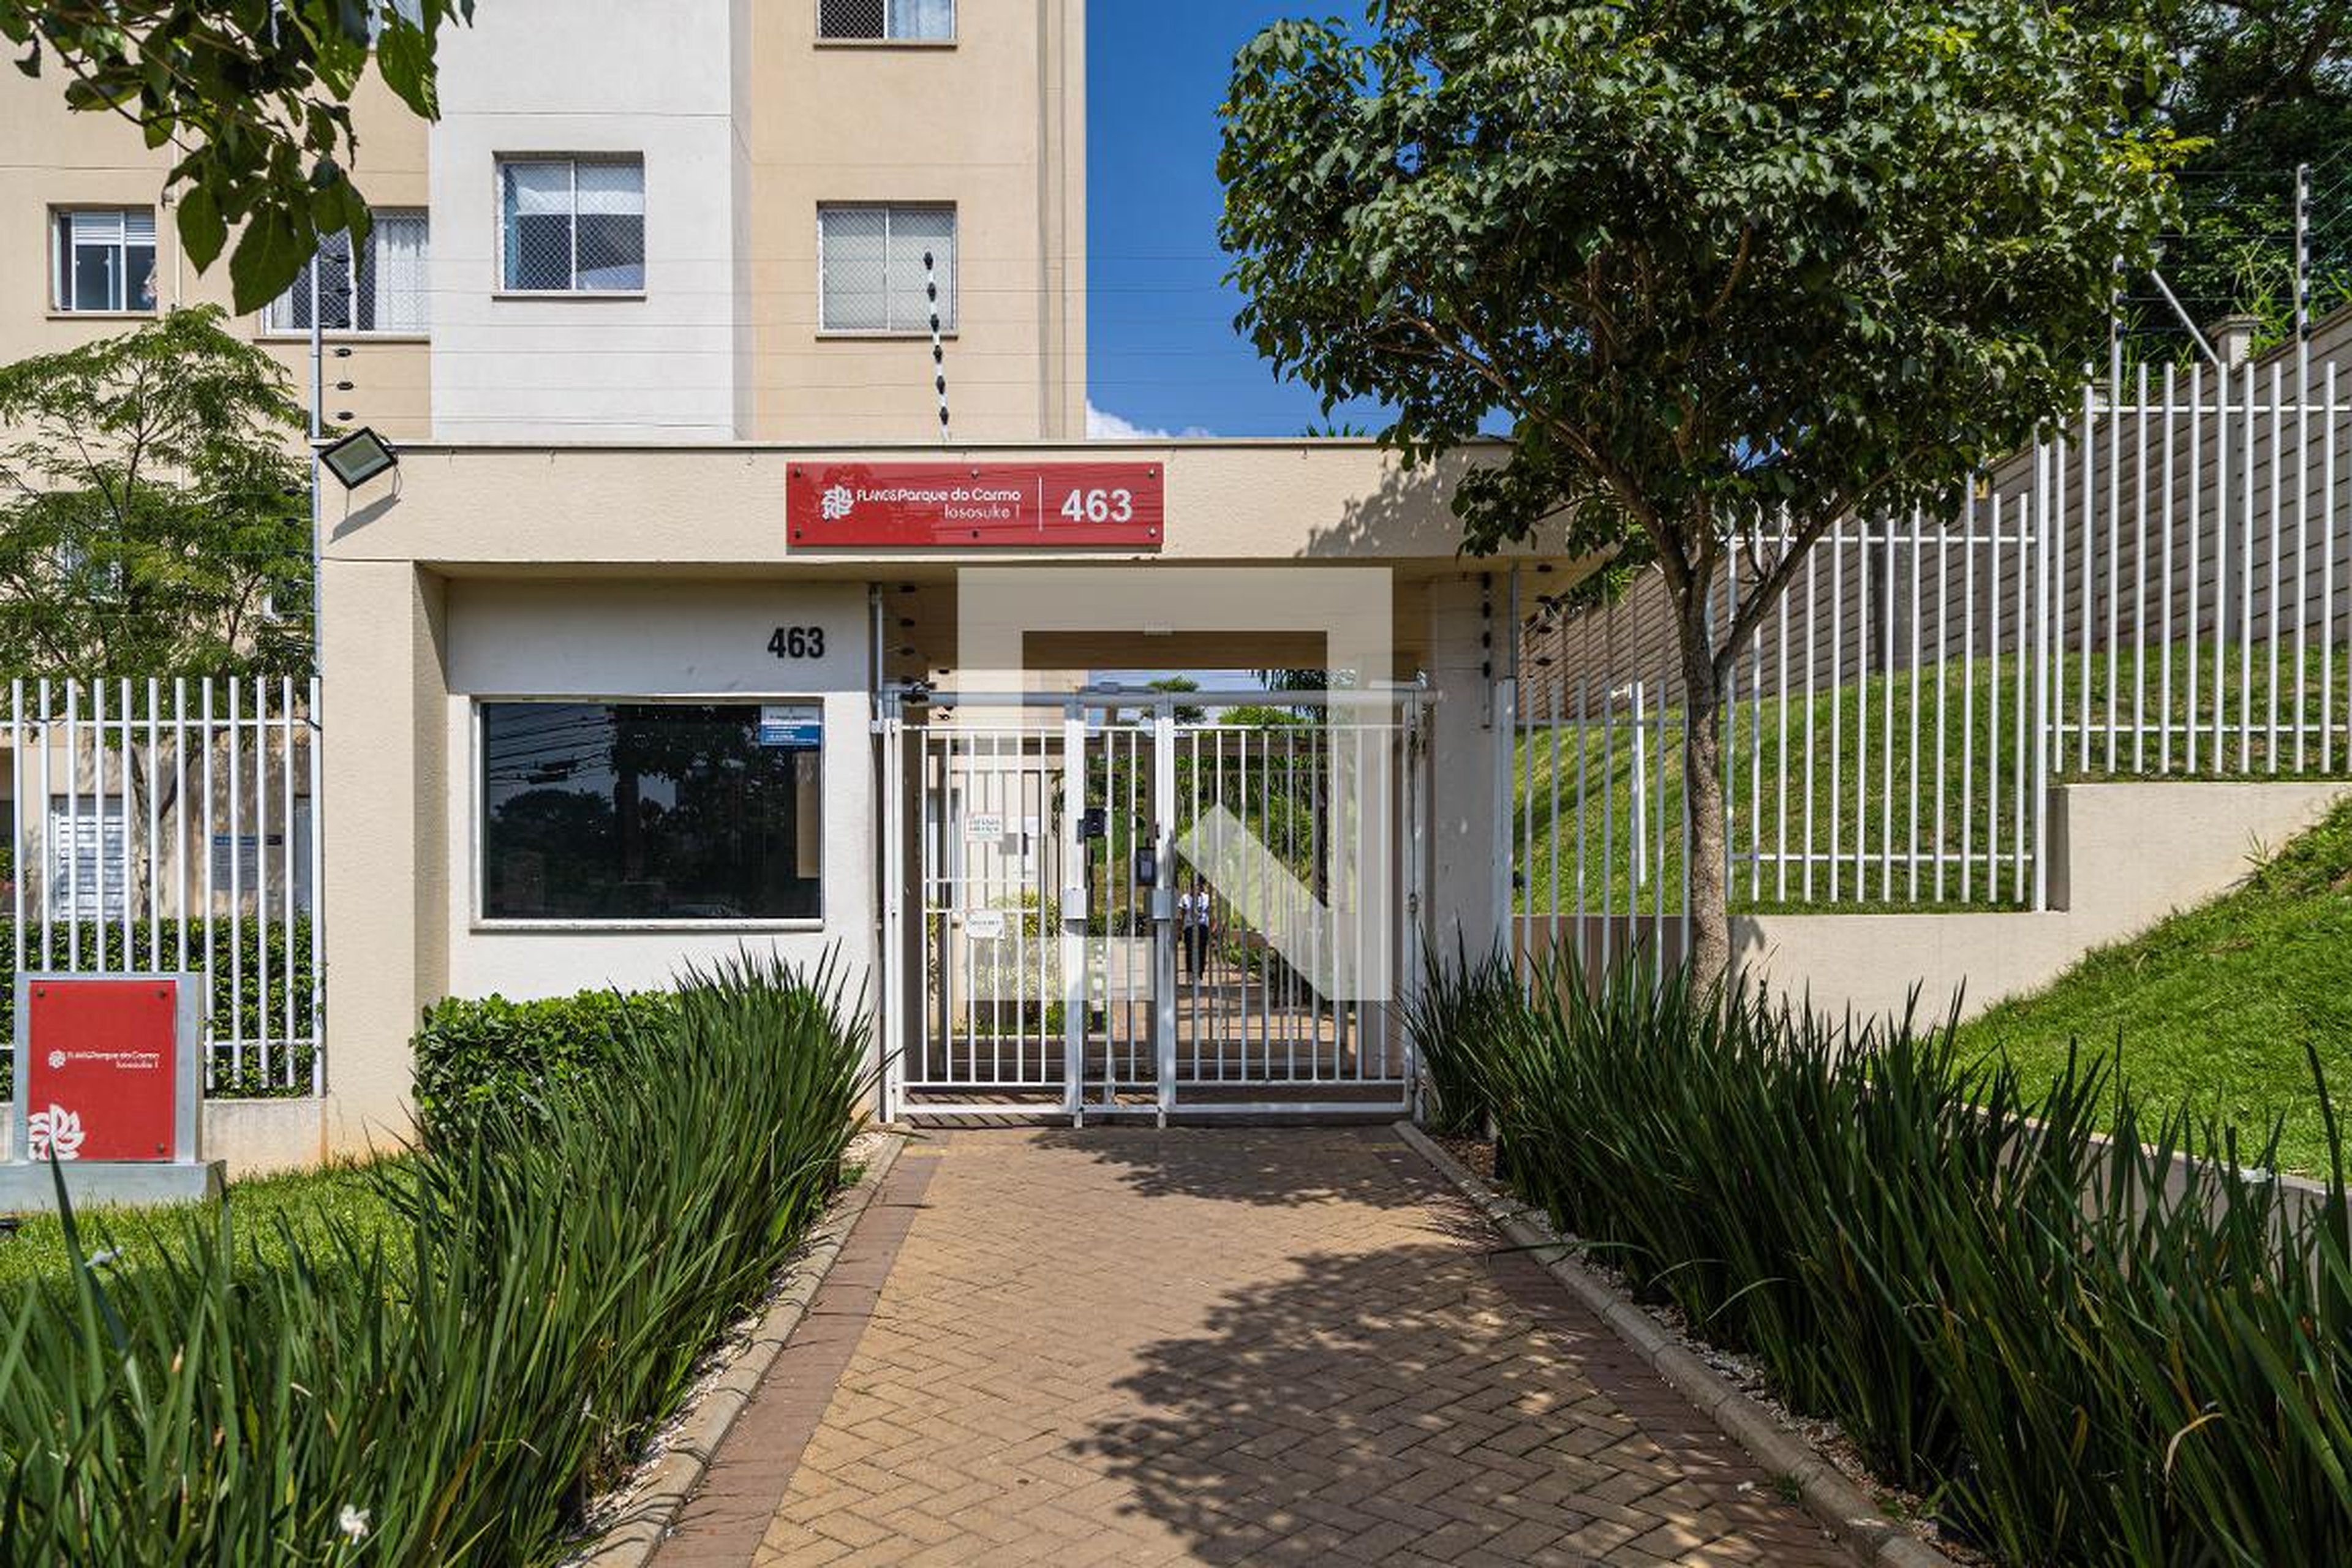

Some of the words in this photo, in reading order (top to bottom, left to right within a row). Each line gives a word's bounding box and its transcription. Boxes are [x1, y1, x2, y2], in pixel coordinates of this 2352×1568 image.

[951, 487, 970, 501] do
[971, 488, 1022, 501] Carmo
[1061, 489, 1133, 523] 463
[767, 627, 825, 659] 463
